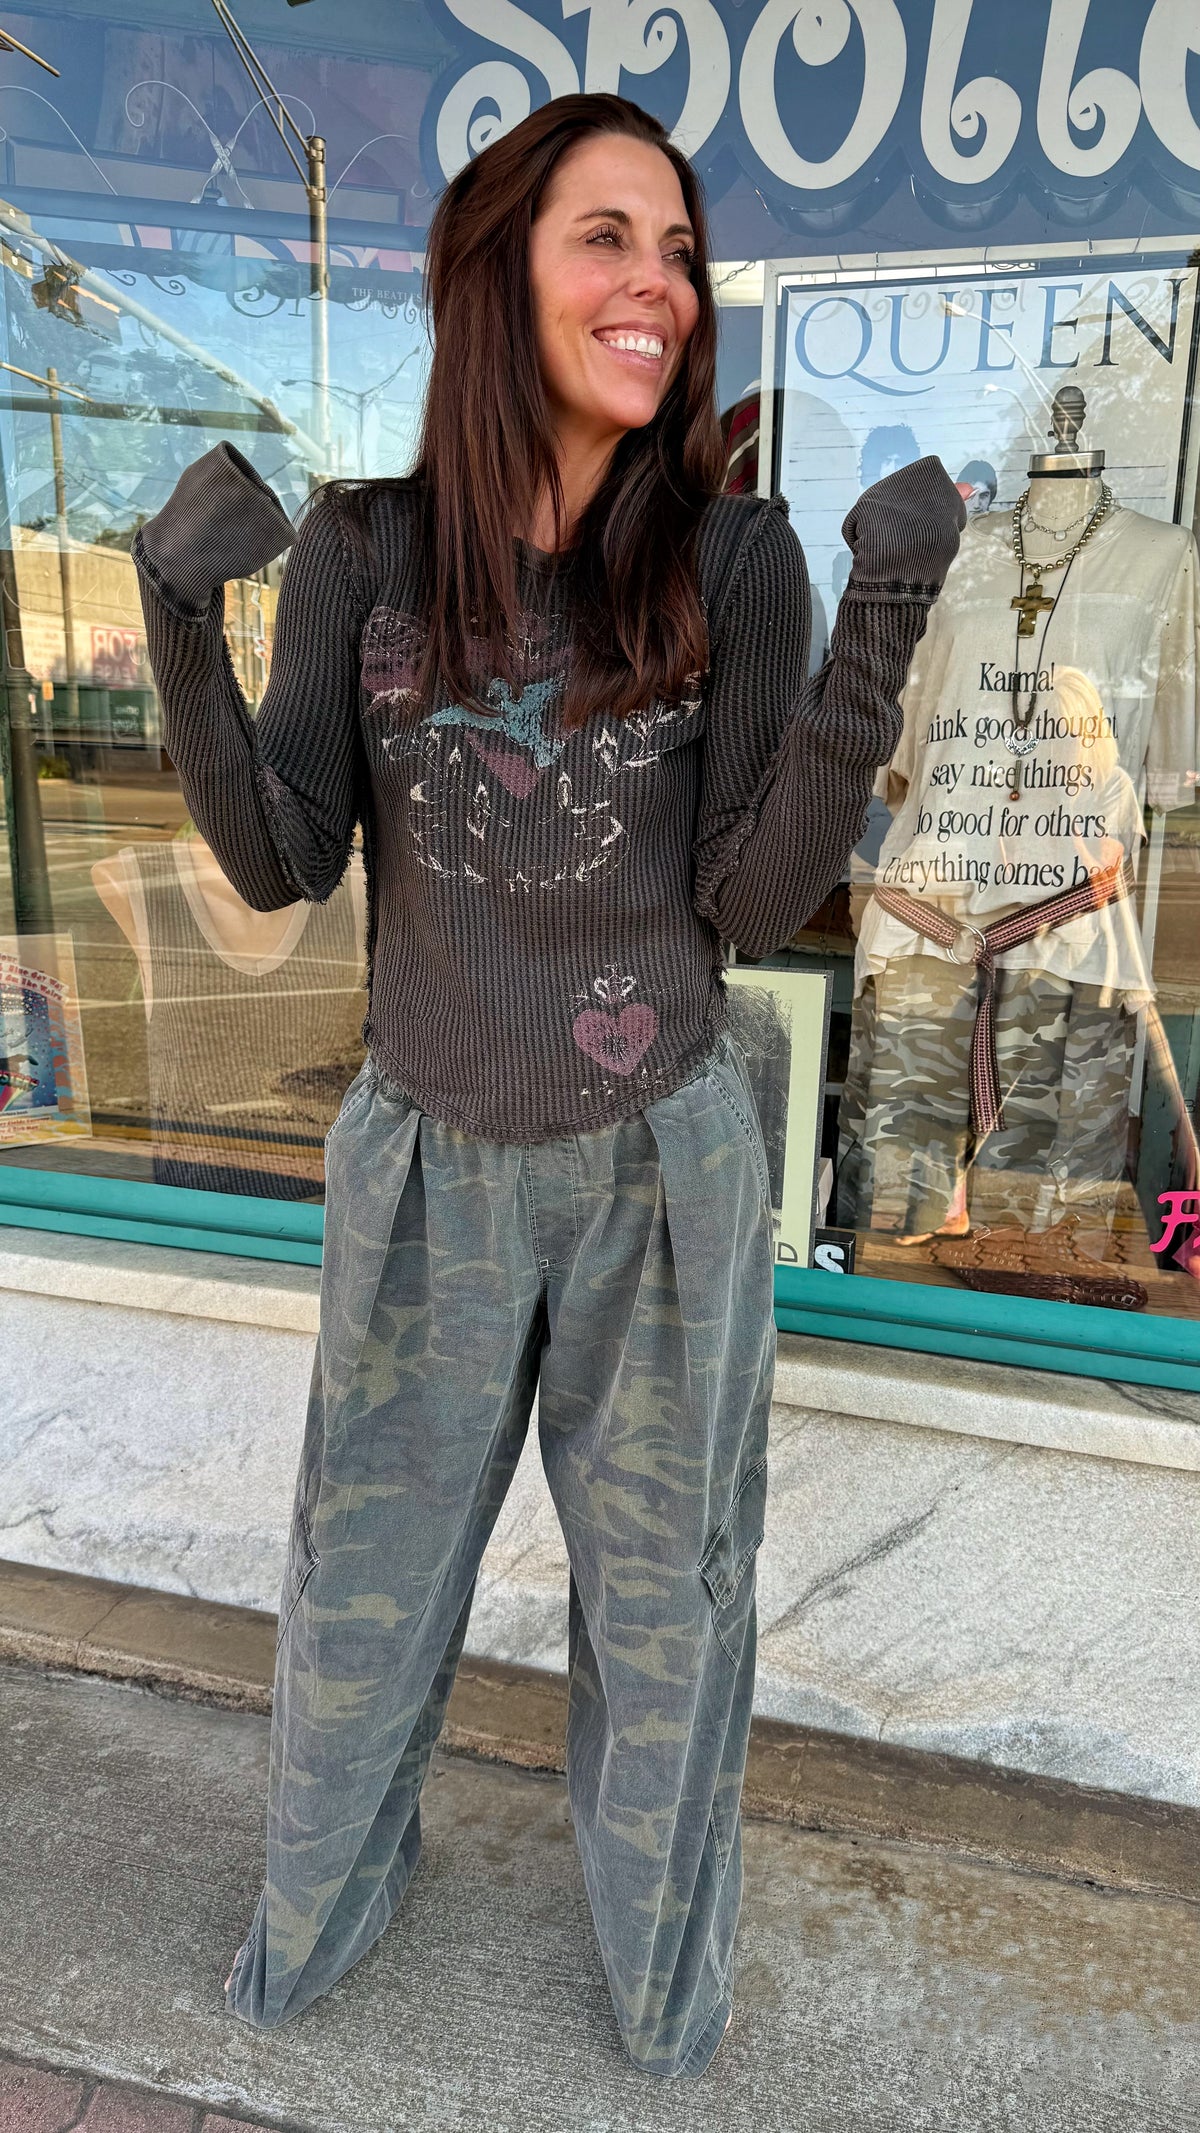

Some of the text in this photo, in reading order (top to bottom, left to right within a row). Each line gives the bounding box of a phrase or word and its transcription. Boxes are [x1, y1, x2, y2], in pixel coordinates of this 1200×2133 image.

[351, 287, 374, 298] THE
[795, 277, 1189, 397] QUEEN
[978, 661, 1055, 693] Karma!
[929, 758, 1095, 797] say nice things,
[937, 805, 994, 843] good
[998, 806, 1030, 838] for
[1034, 805, 1109, 838] others.
[994, 861, 1065, 888] comes
[773, 1241, 799, 1263] D
